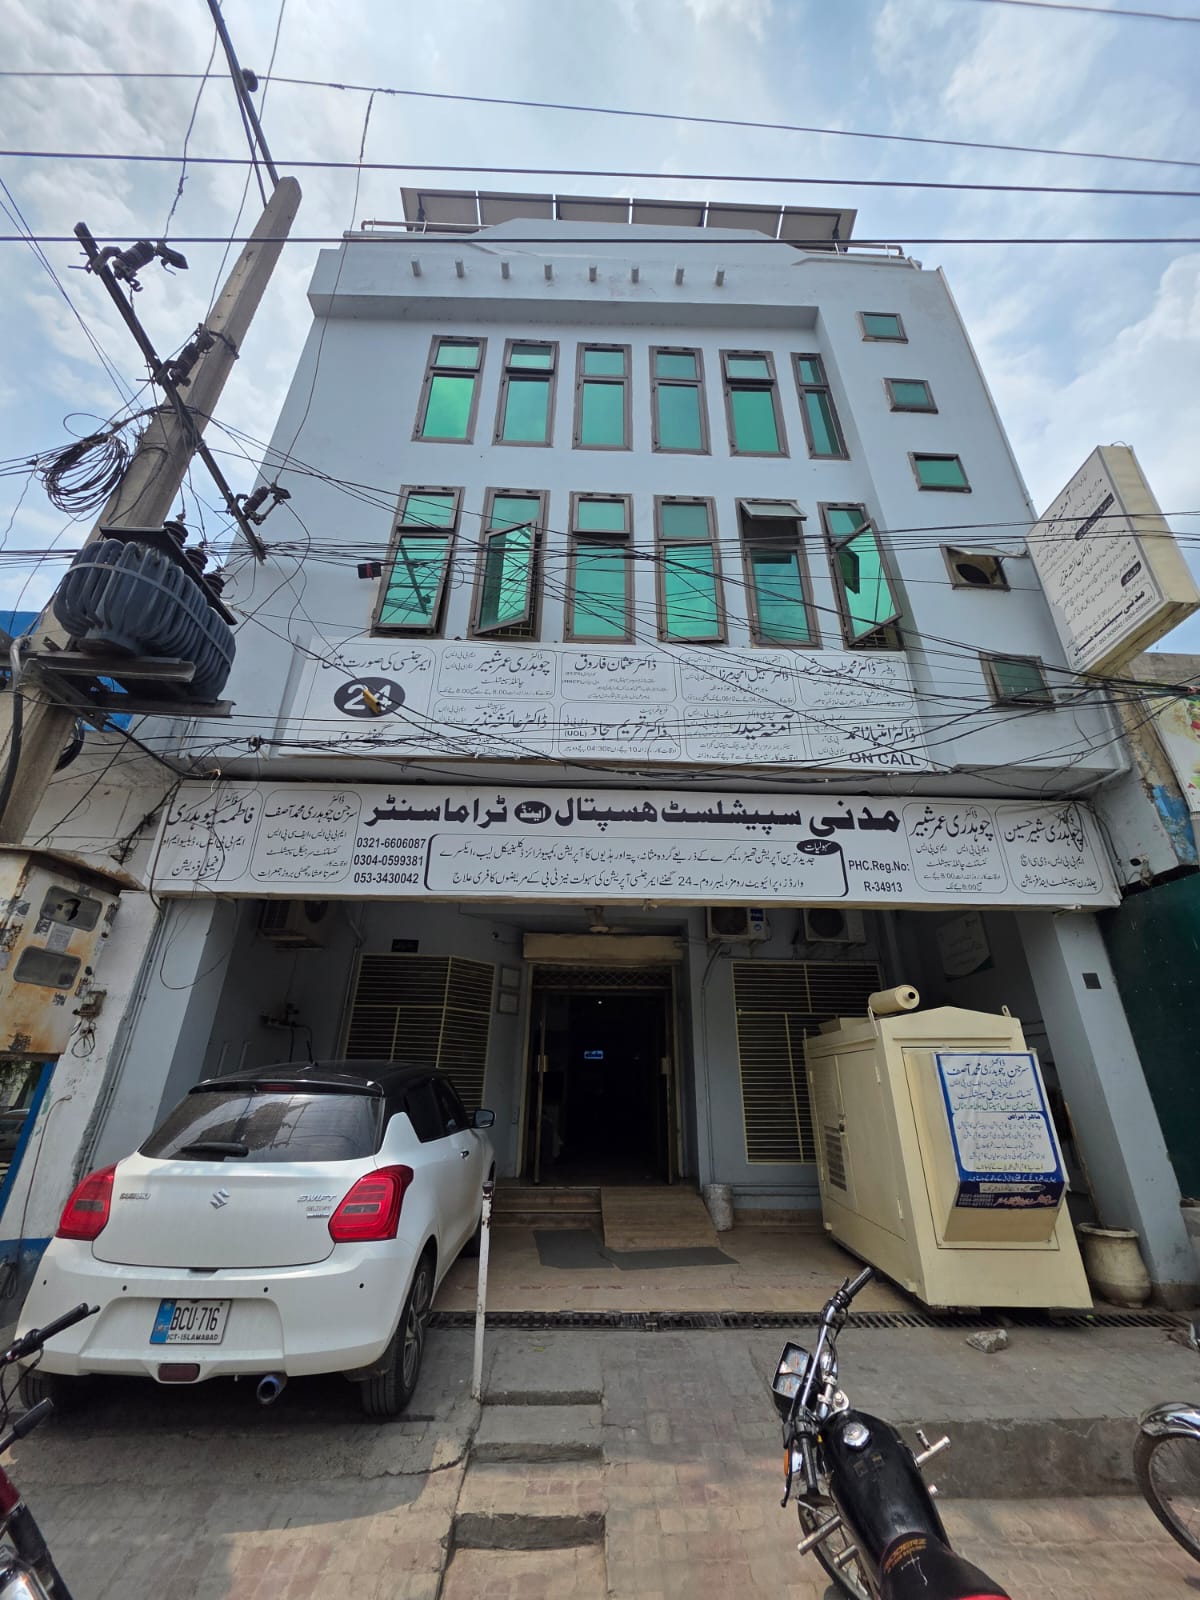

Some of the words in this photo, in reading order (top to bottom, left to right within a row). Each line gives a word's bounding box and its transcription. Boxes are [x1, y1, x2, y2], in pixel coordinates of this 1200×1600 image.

[1124, 591, 1145, 614] مدنی
[345, 657, 383, 669] صورت
[380, 652, 399, 671] کی
[393, 651, 431, 673] ایمرجنسی
[474, 650, 503, 672] شبیر
[490, 657, 511, 674] عمر
[509, 656, 550, 676] چوہدری
[574, 653, 606, 671] فاروق
[607, 655, 633, 672] عثمان
[632, 654, 656, 674] ڈاکٹر
[857, 656, 876, 678] ڈاکٹر
[344, 684, 394, 710] 24
[520, 707, 548, 731] ڈاکٹر
[843, 725, 865, 741] احمد
[864, 723, 892, 746] امتیاز
[890, 719, 916, 746] ڈاکٹر
[849, 752, 874, 763] ON
[878, 752, 921, 766] CALL
[329, 791, 345, 806] ڈاکٹر
[167, 803, 217, 830] چوہدری
[216, 801, 255, 825] فاطمہ
[264, 804, 292, 818] آصف
[291, 804, 305, 819] محمد
[301, 806, 334, 823] چوہدری
[333, 805, 358, 823] سرجن
[364, 793, 441, 827] سنٹر
[445, 794, 507, 829] ٹراما
[519, 804, 547, 821] اینڈ
[661, 799, 802, 836] سپیشلسٹ
[809, 800, 901, 837] مدنی
[909, 806, 936, 837] شبیر
[928, 815, 947, 839] عمر
[946, 815, 993, 842] چوہدری
[1004, 820, 1033, 842] حسین
[1026, 818, 1045, 843] شبیر
[1045, 824, 1084, 846] چوہدری
[234, 835, 245, 849] ایم
[356, 837, 426, 849] 0321-6606087
[439, 840, 472, 858] ایکسرے
[804, 842, 831, 854] سہولیات
[266, 846, 294, 856] سپیشلسٹ
[614, 850, 626, 860] اور
[696, 850, 710, 862] کے
[755, 848, 781, 867] آپریشن
[781, 852, 797, 865] ترین
[171, 859, 200, 876] فزیشن
[198, 855, 219, 876] فیملی
[354, 854, 424, 866] 0304-0599381
[797, 856, 815, 866] جدید
[848, 860, 910, 873] PHC.Reg.No:
[354, 872, 419, 884] 053-3430042
[452, 871, 471, 884] علاج
[473, 869, 490, 885] فری
[496, 871, 528, 887] مریضوں
[527, 870, 539, 883] کے
[558, 873, 569, 886] نیز
[570, 872, 597, 886] سہولت
[594, 870, 605, 887] کی
[603, 870, 630, 889] آپریشن
[630, 869, 659, 889] ایمرجنسی
[678, 875, 693, 887] 24
[1049, 877, 1078, 887] سپیشلسٹ
[864, 881, 903, 892] R-34913
[947, 1063, 970, 1076] آصف
[971, 1062, 981, 1076] محمد
[981, 1064, 1007, 1076] چوہدری
[1007, 1064, 1029, 1078] سرجن
[297, 1194, 337, 1202] SWIFT
